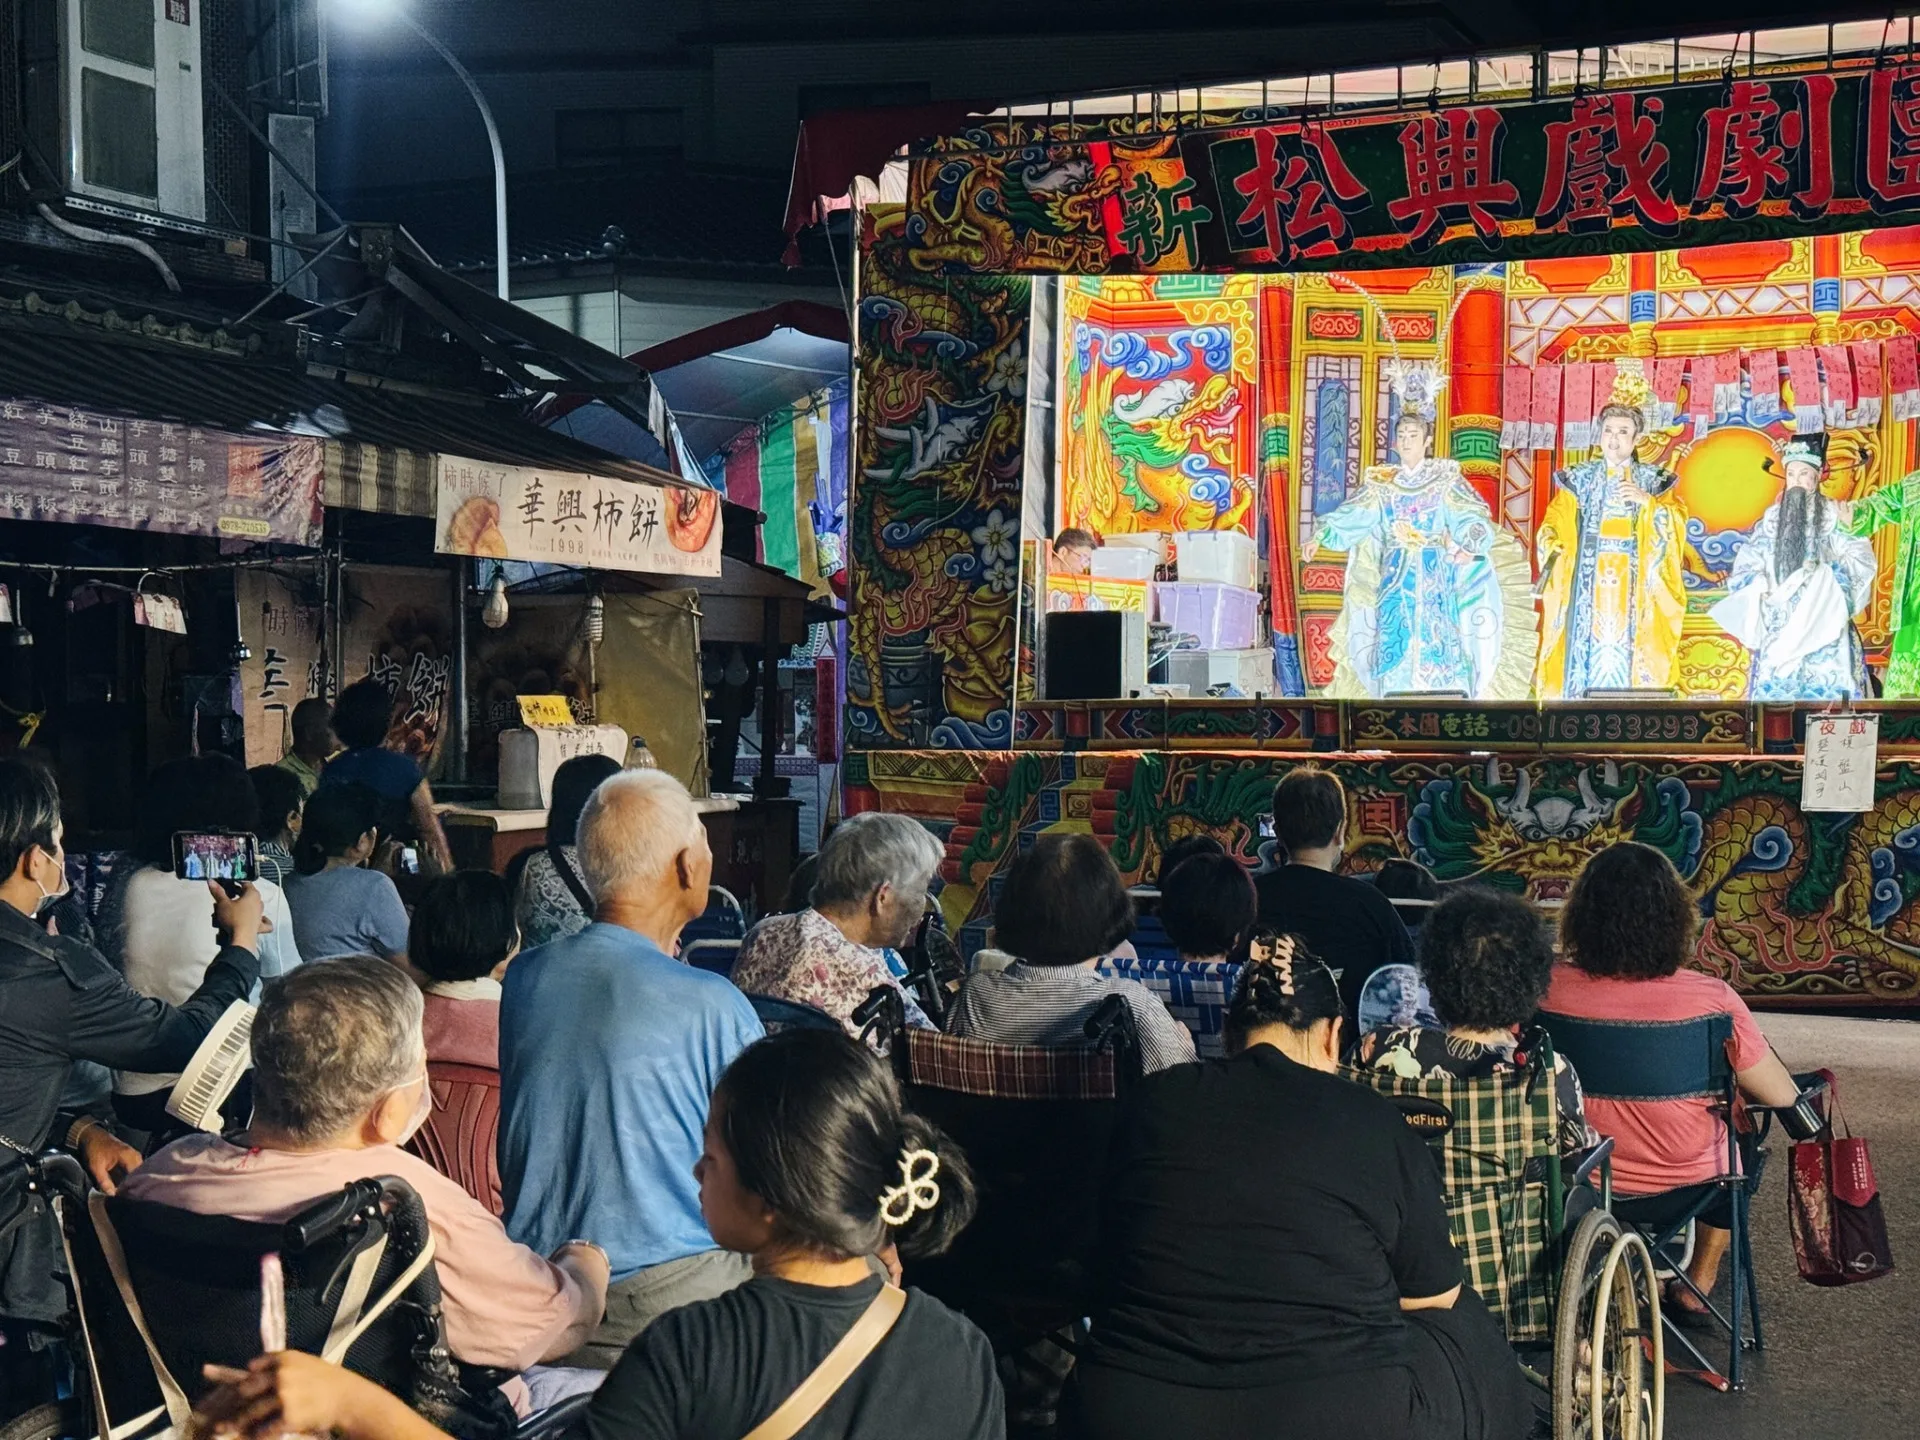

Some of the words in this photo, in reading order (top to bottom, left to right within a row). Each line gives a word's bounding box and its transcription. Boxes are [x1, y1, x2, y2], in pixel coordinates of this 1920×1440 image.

[517, 477, 660, 549] 華興柿餅
[550, 537, 584, 555] 1998
[1507, 713, 1699, 740] 0916333293
[1401, 1112, 1448, 1127] edFirst
